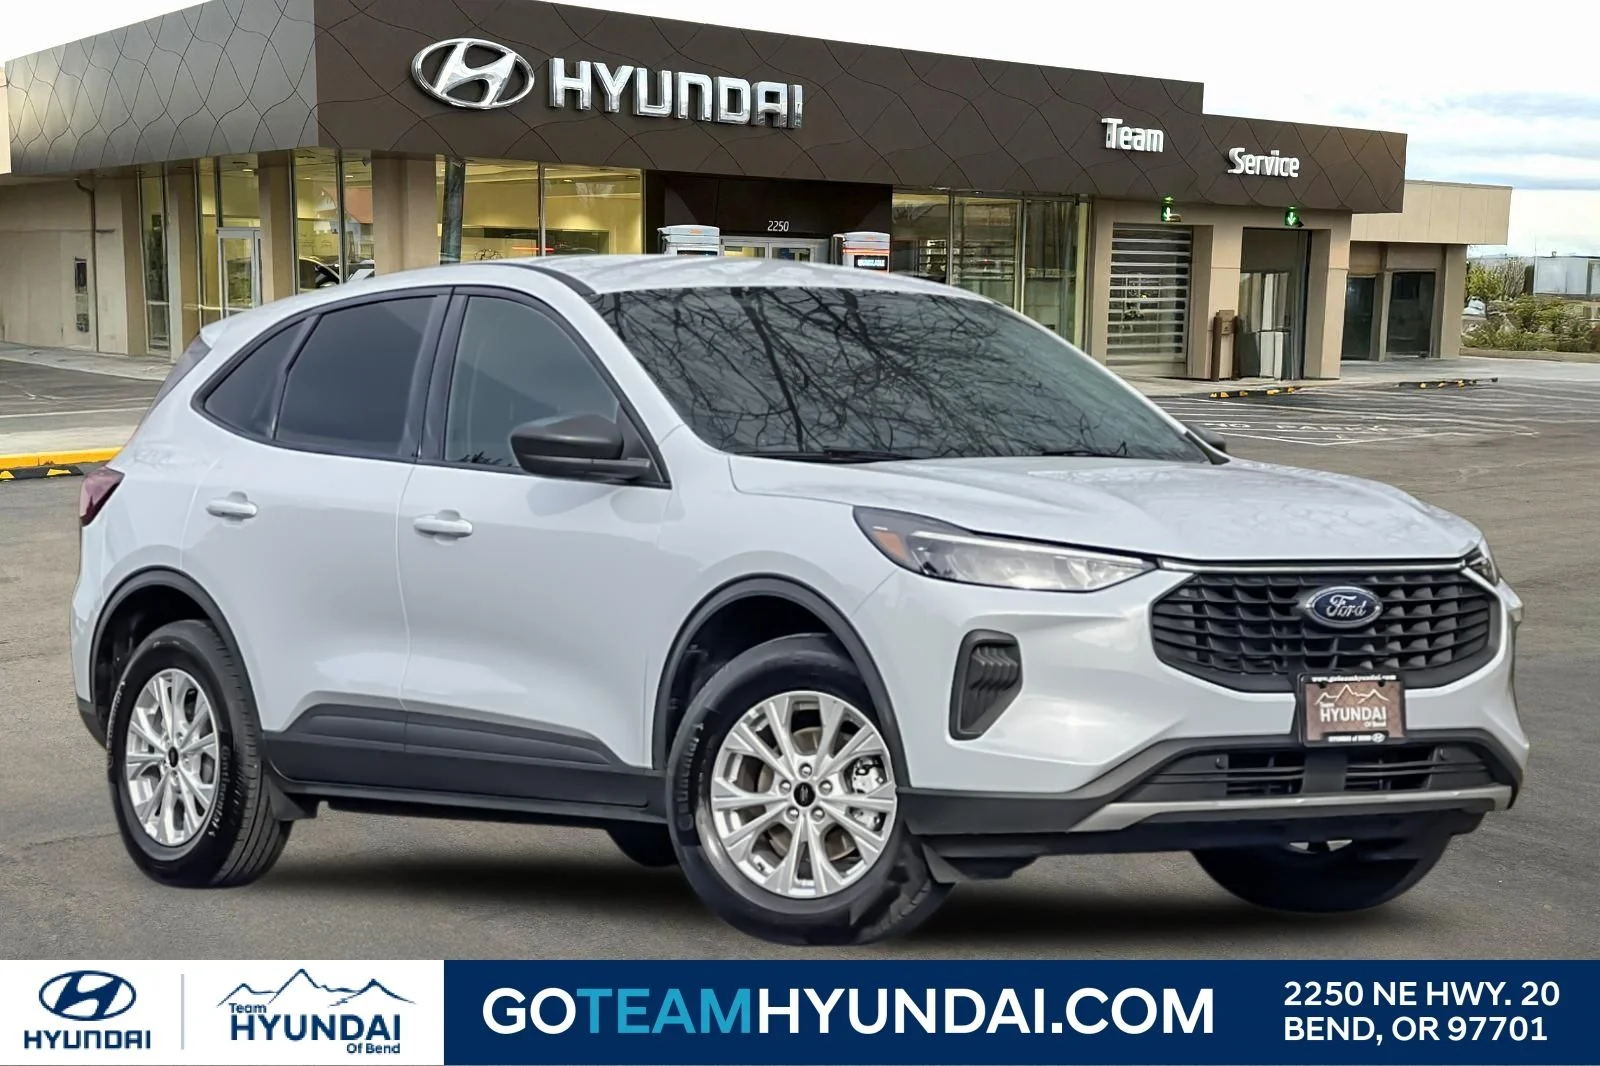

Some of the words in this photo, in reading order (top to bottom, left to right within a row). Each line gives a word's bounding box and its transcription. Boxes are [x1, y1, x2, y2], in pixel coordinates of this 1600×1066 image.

[549, 57, 803, 129] HYUNDAI
[1101, 117, 1164, 152] Team
[1227, 147, 1300, 178] Service
[767, 220, 790, 232] 2250
[1325, 594, 1367, 617] Ford
[1320, 706, 1387, 723] HYUNDAI
